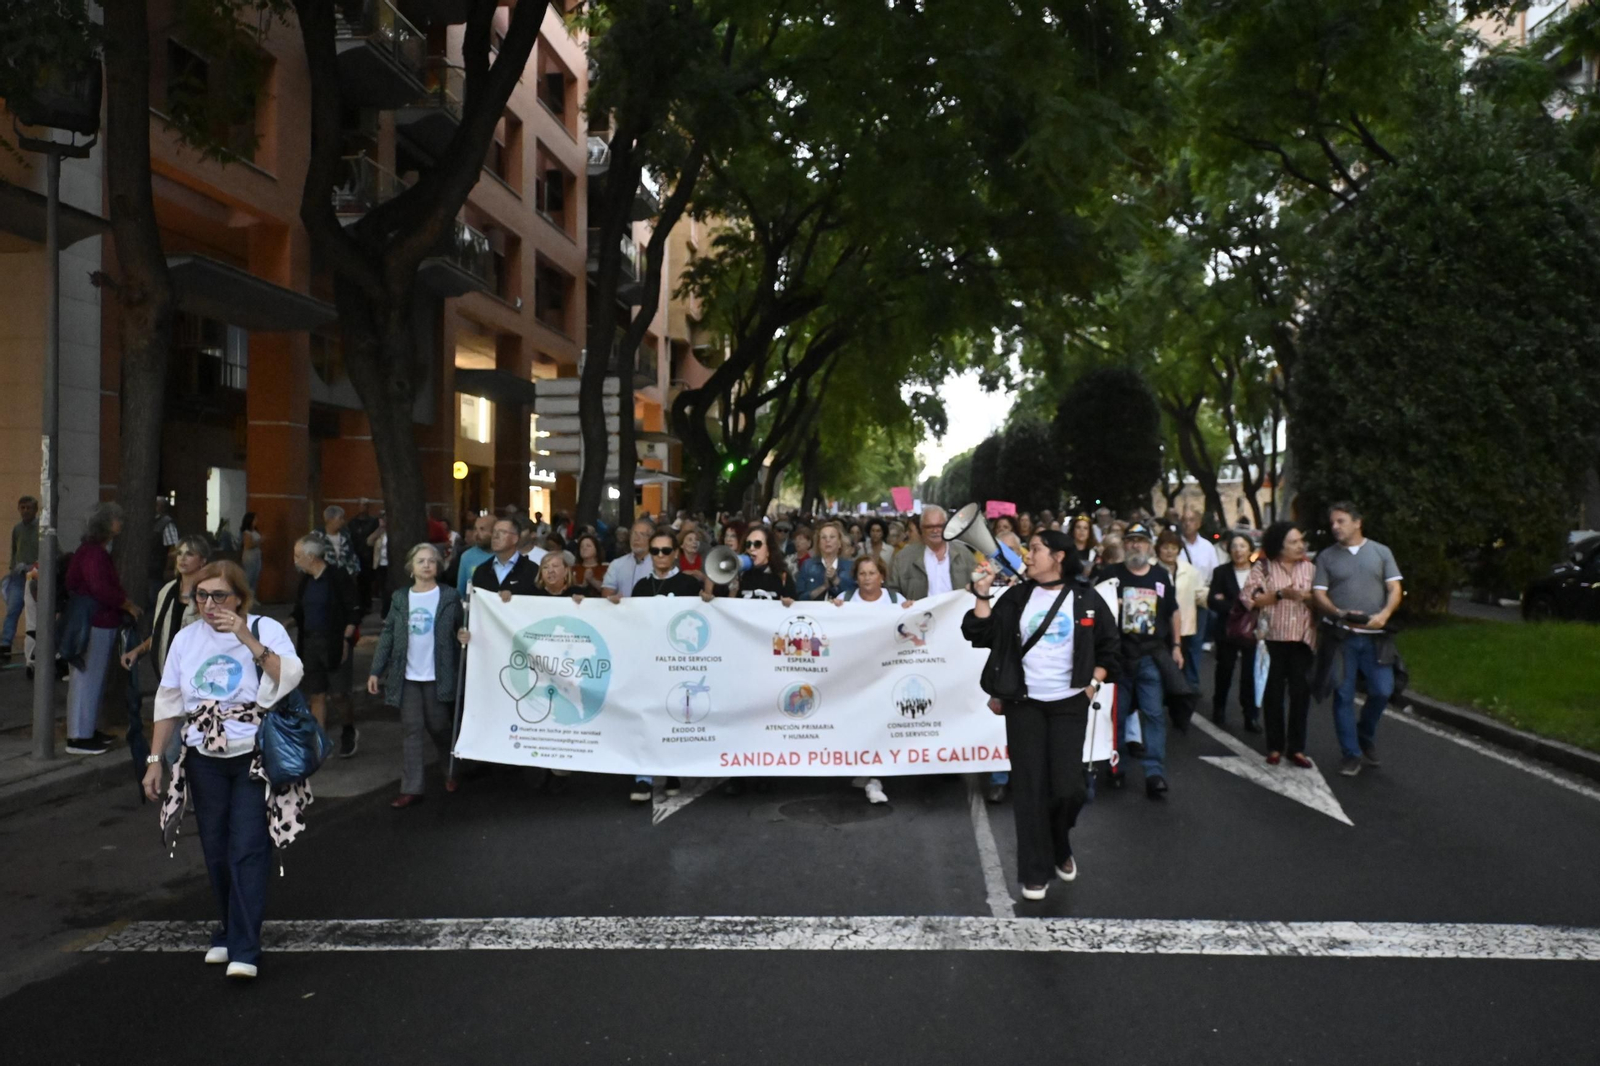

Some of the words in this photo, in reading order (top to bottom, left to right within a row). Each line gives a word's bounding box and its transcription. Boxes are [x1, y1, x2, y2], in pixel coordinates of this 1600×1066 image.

[897, 648, 929, 656] HOSPITAL
[509, 650, 611, 679] ONUSAP
[881, 658, 946, 667] MATERNO-INFANTIL
[720, 751, 800, 767] SANIDAD
[808, 748, 883, 766] PÚBLICA
[890, 750, 900, 764] Y
[908, 748, 930, 764] DE
[936, 744, 1010, 762] CALIDA
